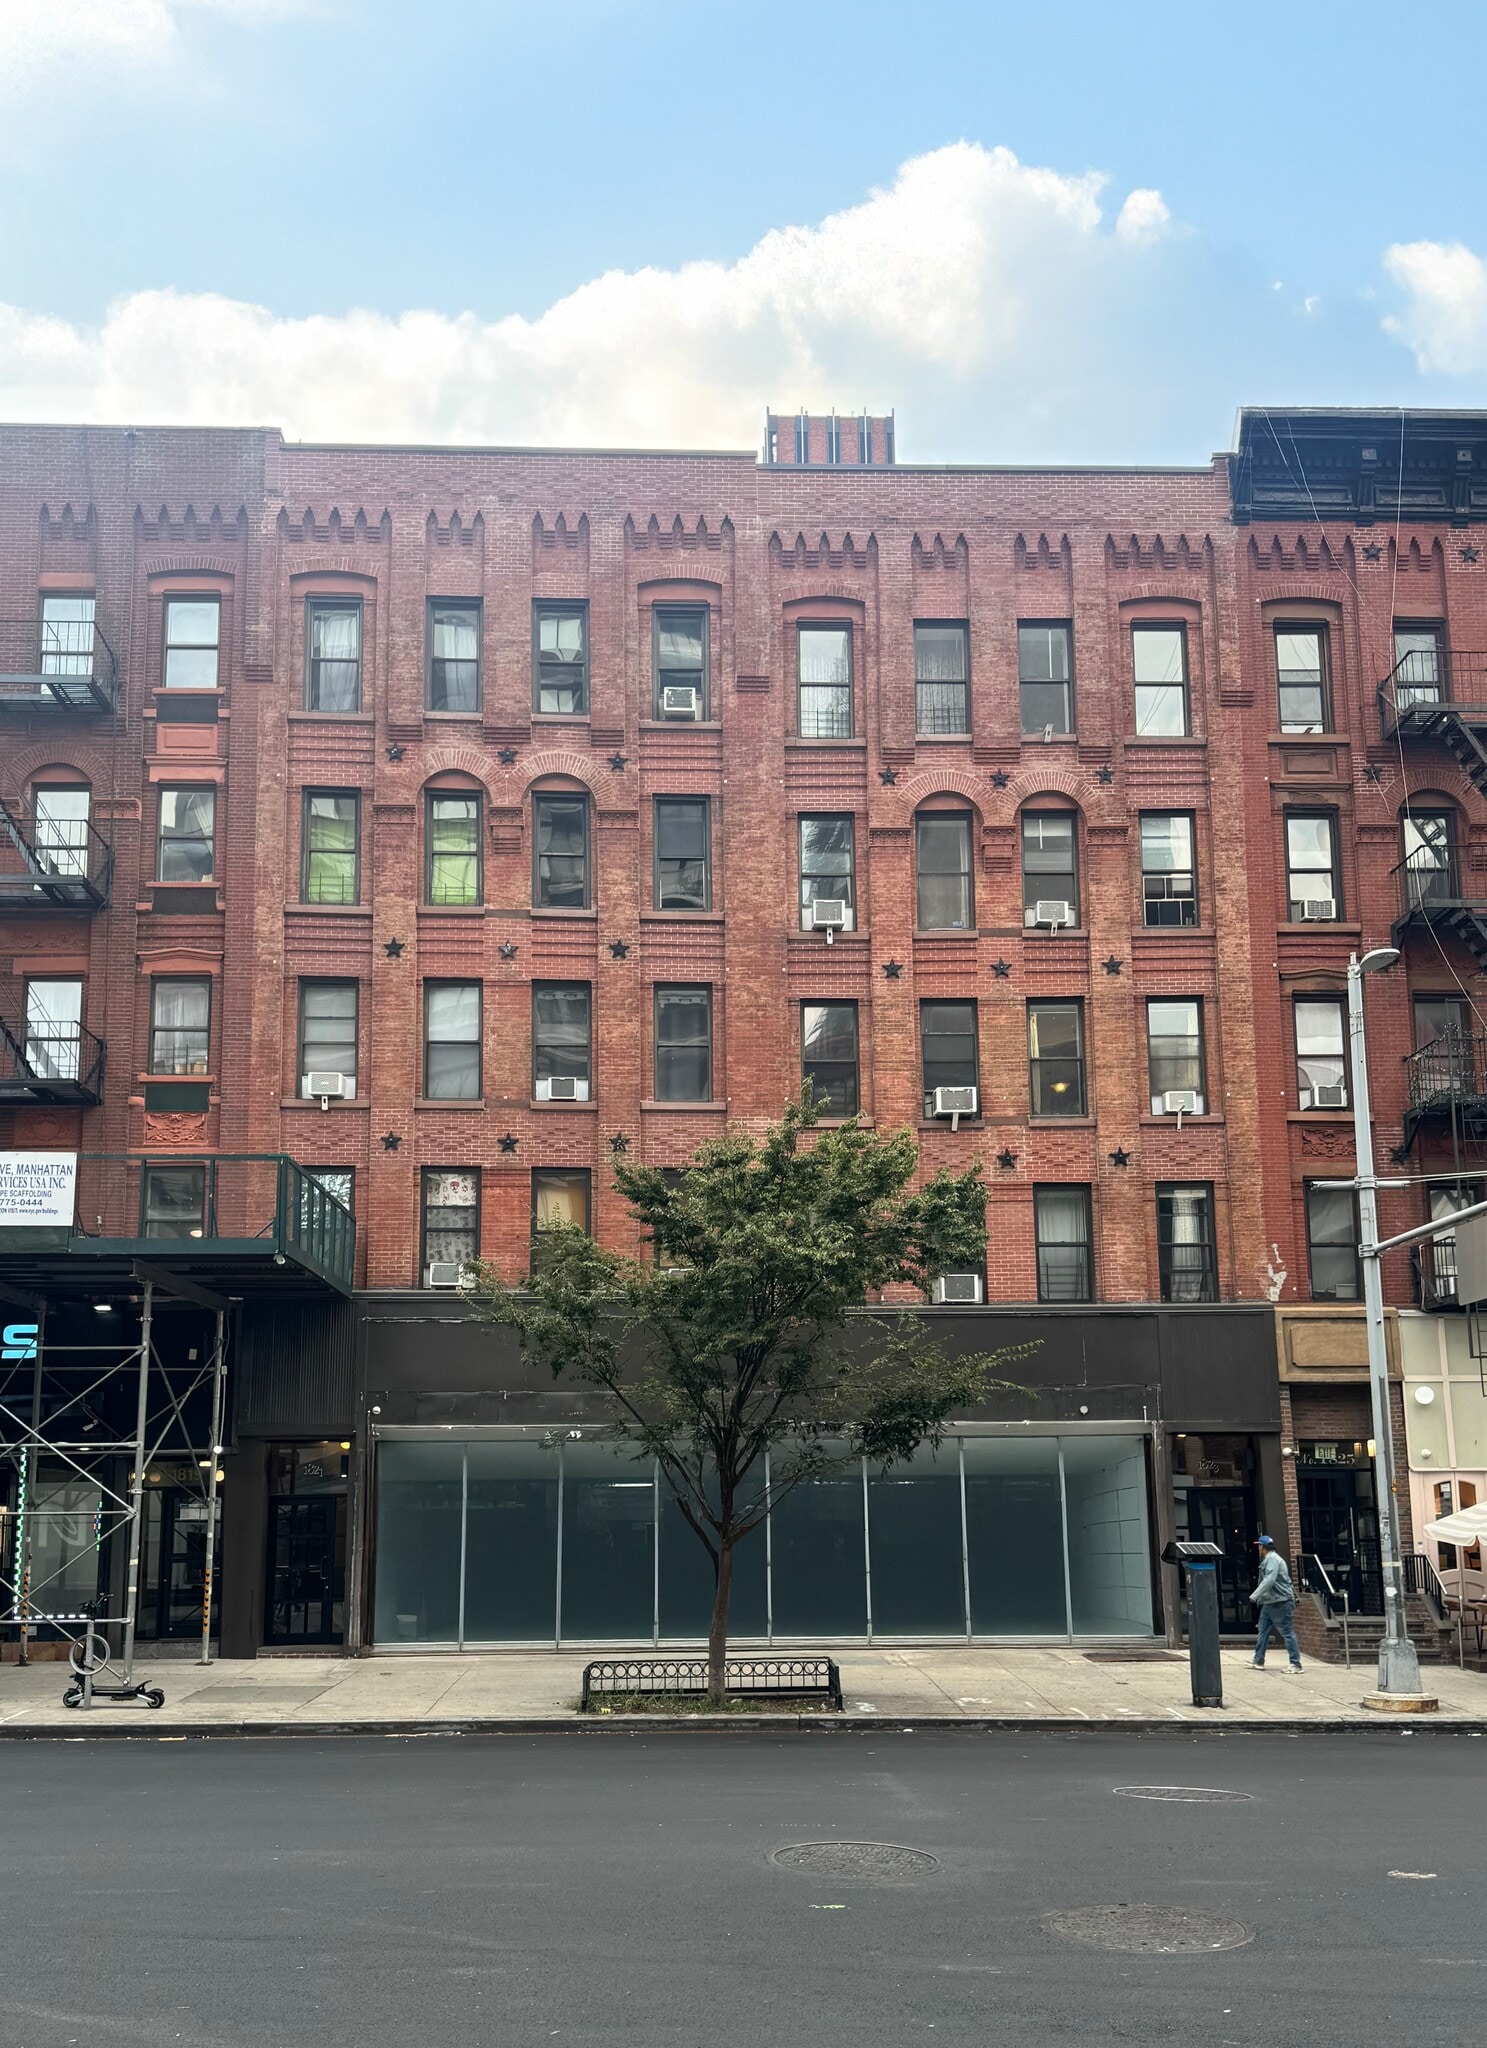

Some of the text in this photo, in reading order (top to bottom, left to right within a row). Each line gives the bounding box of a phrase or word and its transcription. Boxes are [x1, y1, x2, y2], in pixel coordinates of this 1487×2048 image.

[16, 1164, 73, 1175] MANHATTAN
[30, 1177, 46, 1188] USA
[49, 1177, 66, 1189] INC.
[9, 1190, 52, 1198] SCAFFOLDING
[1320, 1453, 1355, 1464] 1825
